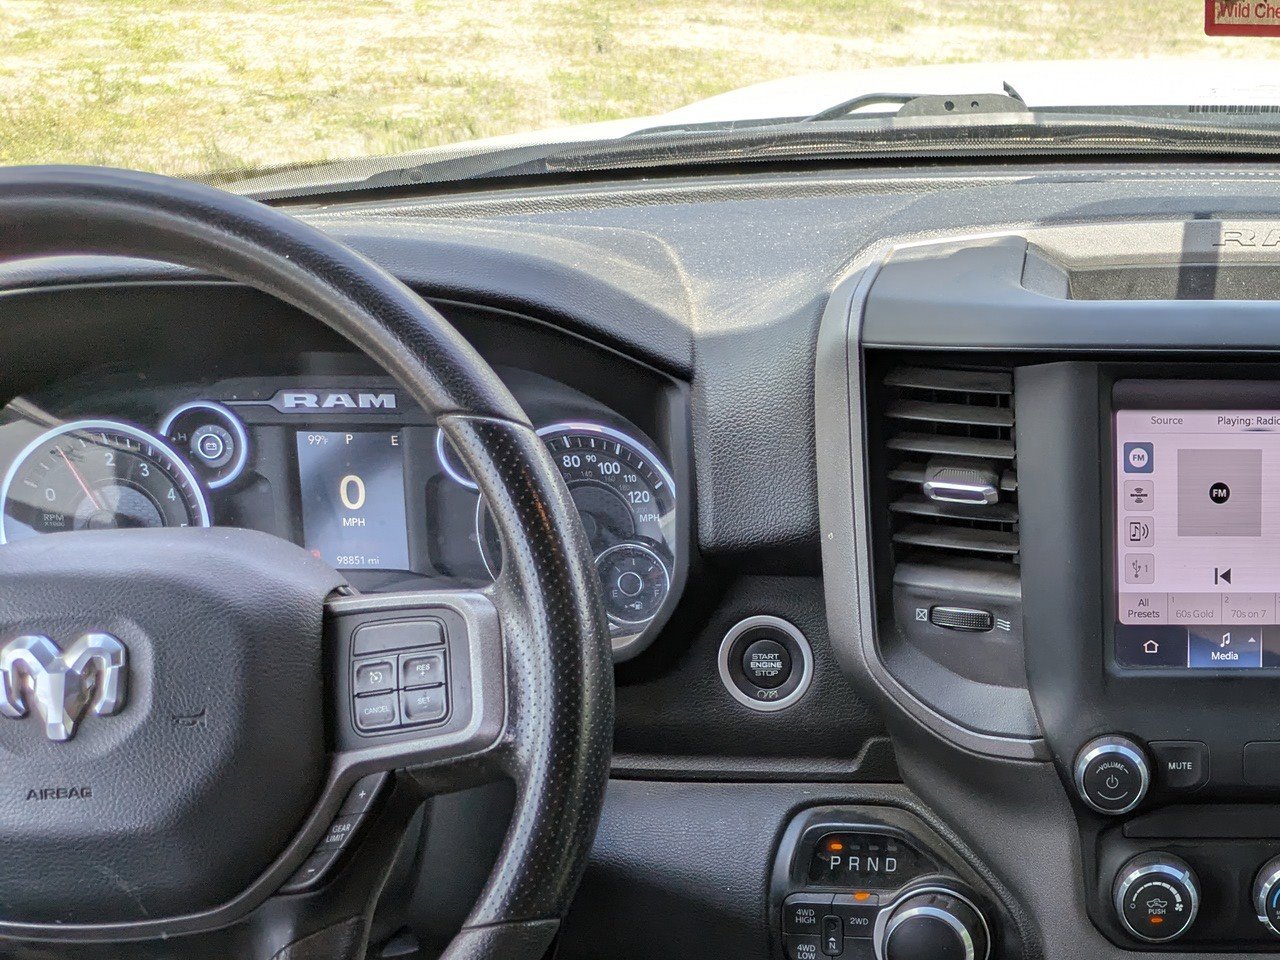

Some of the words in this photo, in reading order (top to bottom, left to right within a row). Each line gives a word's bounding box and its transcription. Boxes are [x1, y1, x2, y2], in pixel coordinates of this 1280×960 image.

[1218, 3, 1250, 18] Wild
[283, 393, 397, 409] RAM
[1150, 416, 1184, 426] Source
[1217, 416, 1254, 427] Playing:
[346, 434, 354, 444] P
[391, 436, 398, 446] E
[104, 453, 116, 466] 2
[562, 455, 580, 468] 80
[586, 454, 596, 462] 90
[140, 463, 150, 476] 3
[598, 462, 620, 475] 100
[624, 474, 636, 482] 110
[46, 488, 56, 501] 0
[167, 488, 176, 500] 4
[339, 474, 366, 510] 0
[1212, 488, 1228, 498] FM
[628, 490, 650, 504] 120
[43, 514, 64, 522] RPM
[640, 514, 660, 522] MPH
[342, 518, 366, 527] MPH
[336, 556, 364, 565] 98851
[368, 556, 380, 564] mi
[612, 590, 618, 598] E
[654, 590, 660, 598] F
[1138, 598, 1150, 606] All
[1128, 610, 1160, 618] Presets
[1175, 610, 1192, 618] 60s
[1193, 610, 1214, 618] Gold
[1231, 610, 1246, 618] 70s
[1260, 610, 1267, 618] 7
[1211, 651, 1239, 660] Media
[416, 664, 430, 672] RES
[416, 696, 432, 704] SET
[364, 706, 389, 714] CANCEL
[1099, 763, 1125, 772] VOLUME
[1168, 762, 1192, 770] MUTE
[26, 786, 93, 801] AIRBAG
[332, 824, 352, 832] GEAR
[326, 834, 345, 842] LIMIT
[830, 856, 841, 870] P
[848, 856, 860, 871] R
[867, 857, 878, 872] N
[886, 858, 897, 872] D
[796, 908, 815, 916] 4WD
[796, 916, 816, 924] HIGH
[850, 918, 869, 926] 2WD
[796, 944, 816, 952] 4WD
[828, 942, 836, 950] N
[797, 952, 816, 960] LOW
